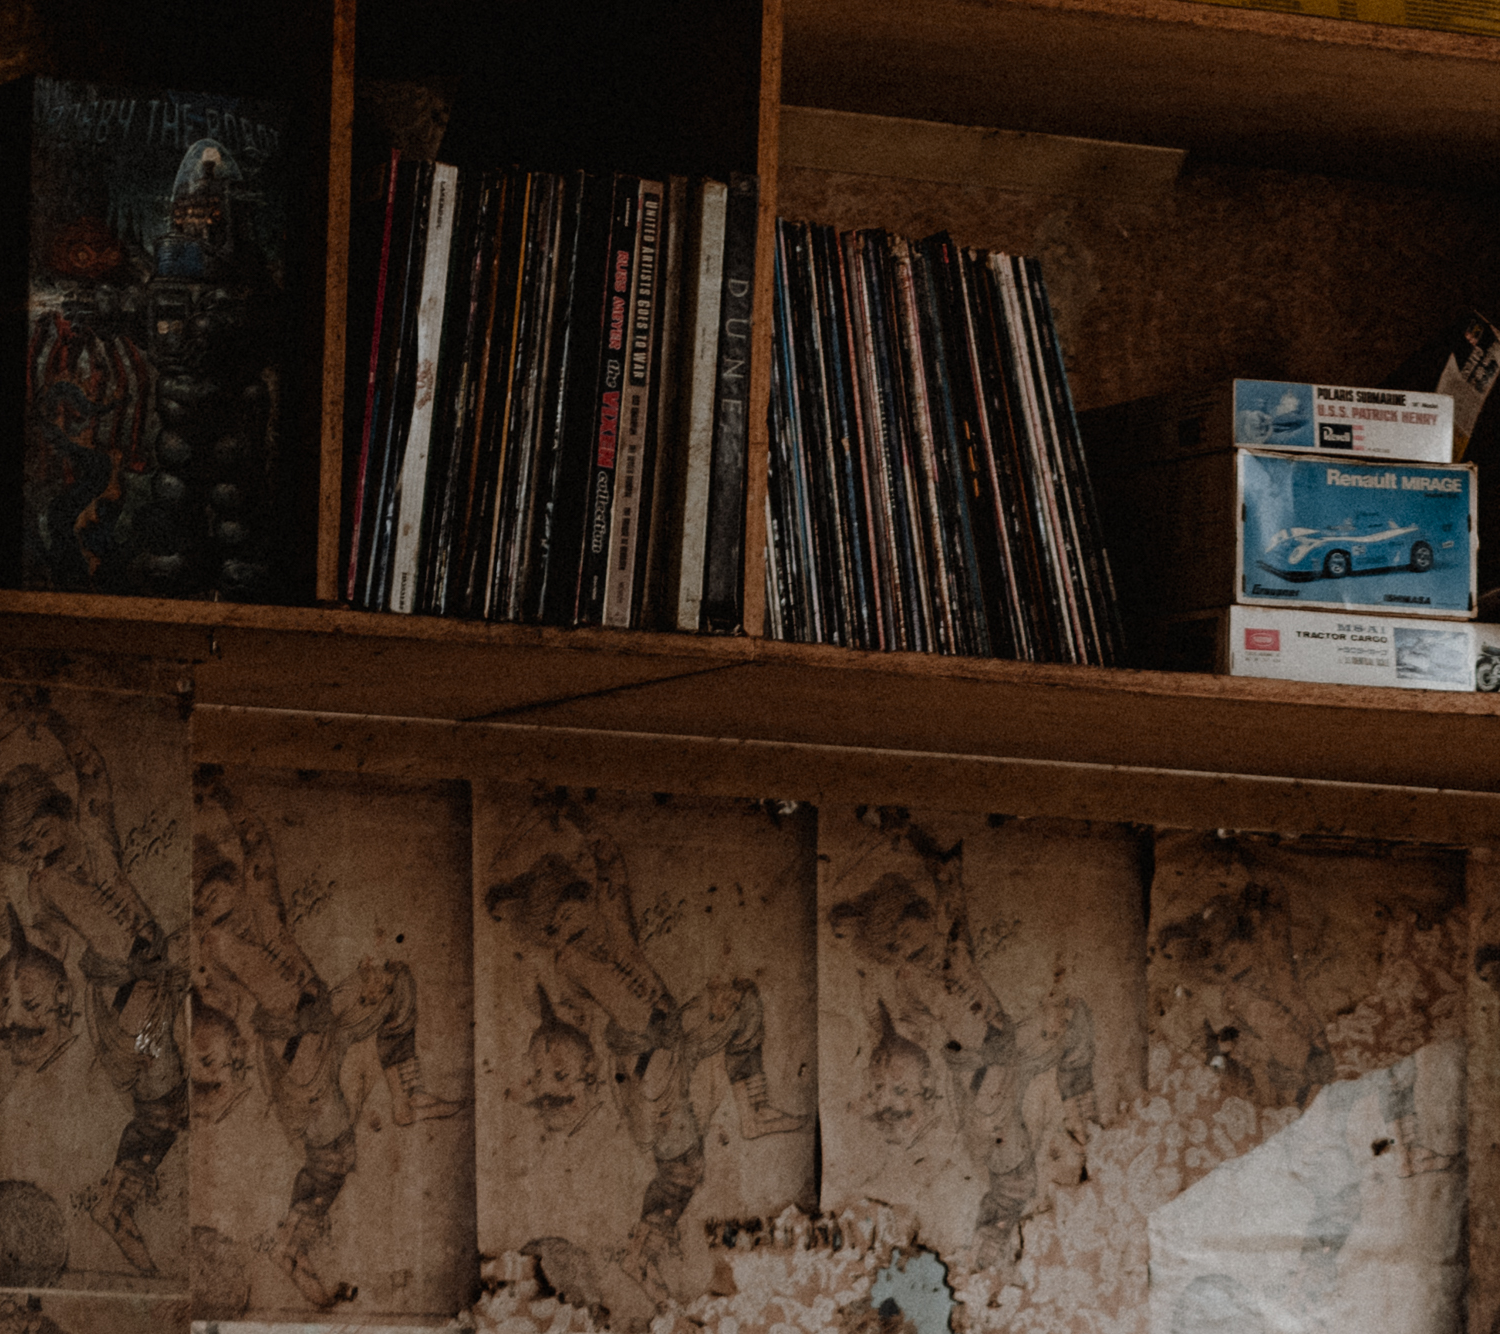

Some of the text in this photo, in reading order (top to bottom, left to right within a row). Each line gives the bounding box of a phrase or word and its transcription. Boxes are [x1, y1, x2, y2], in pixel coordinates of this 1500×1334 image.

[146, 98, 194, 148] THE
[643, 199, 659, 242] UNITED
[639, 245, 656, 296] ARTISTS
[636, 299, 651, 329] GOES
[635, 334, 649, 349] TO
[721, 277, 750, 415] DUNE
[632, 352, 646, 379] WAR
[591, 249, 630, 554] RUSS MEYER the VIXEN collection
[1317, 387, 1353, 402] POLARIS
[1356, 390, 1406, 407] SUBMARINE
[1317, 404, 1438, 426] U.S.S. PATRICK HENRY
[1326, 468, 1463, 494] Renault MIRAGE
[1296, 630, 1388, 644] TRACTOR CARGO
